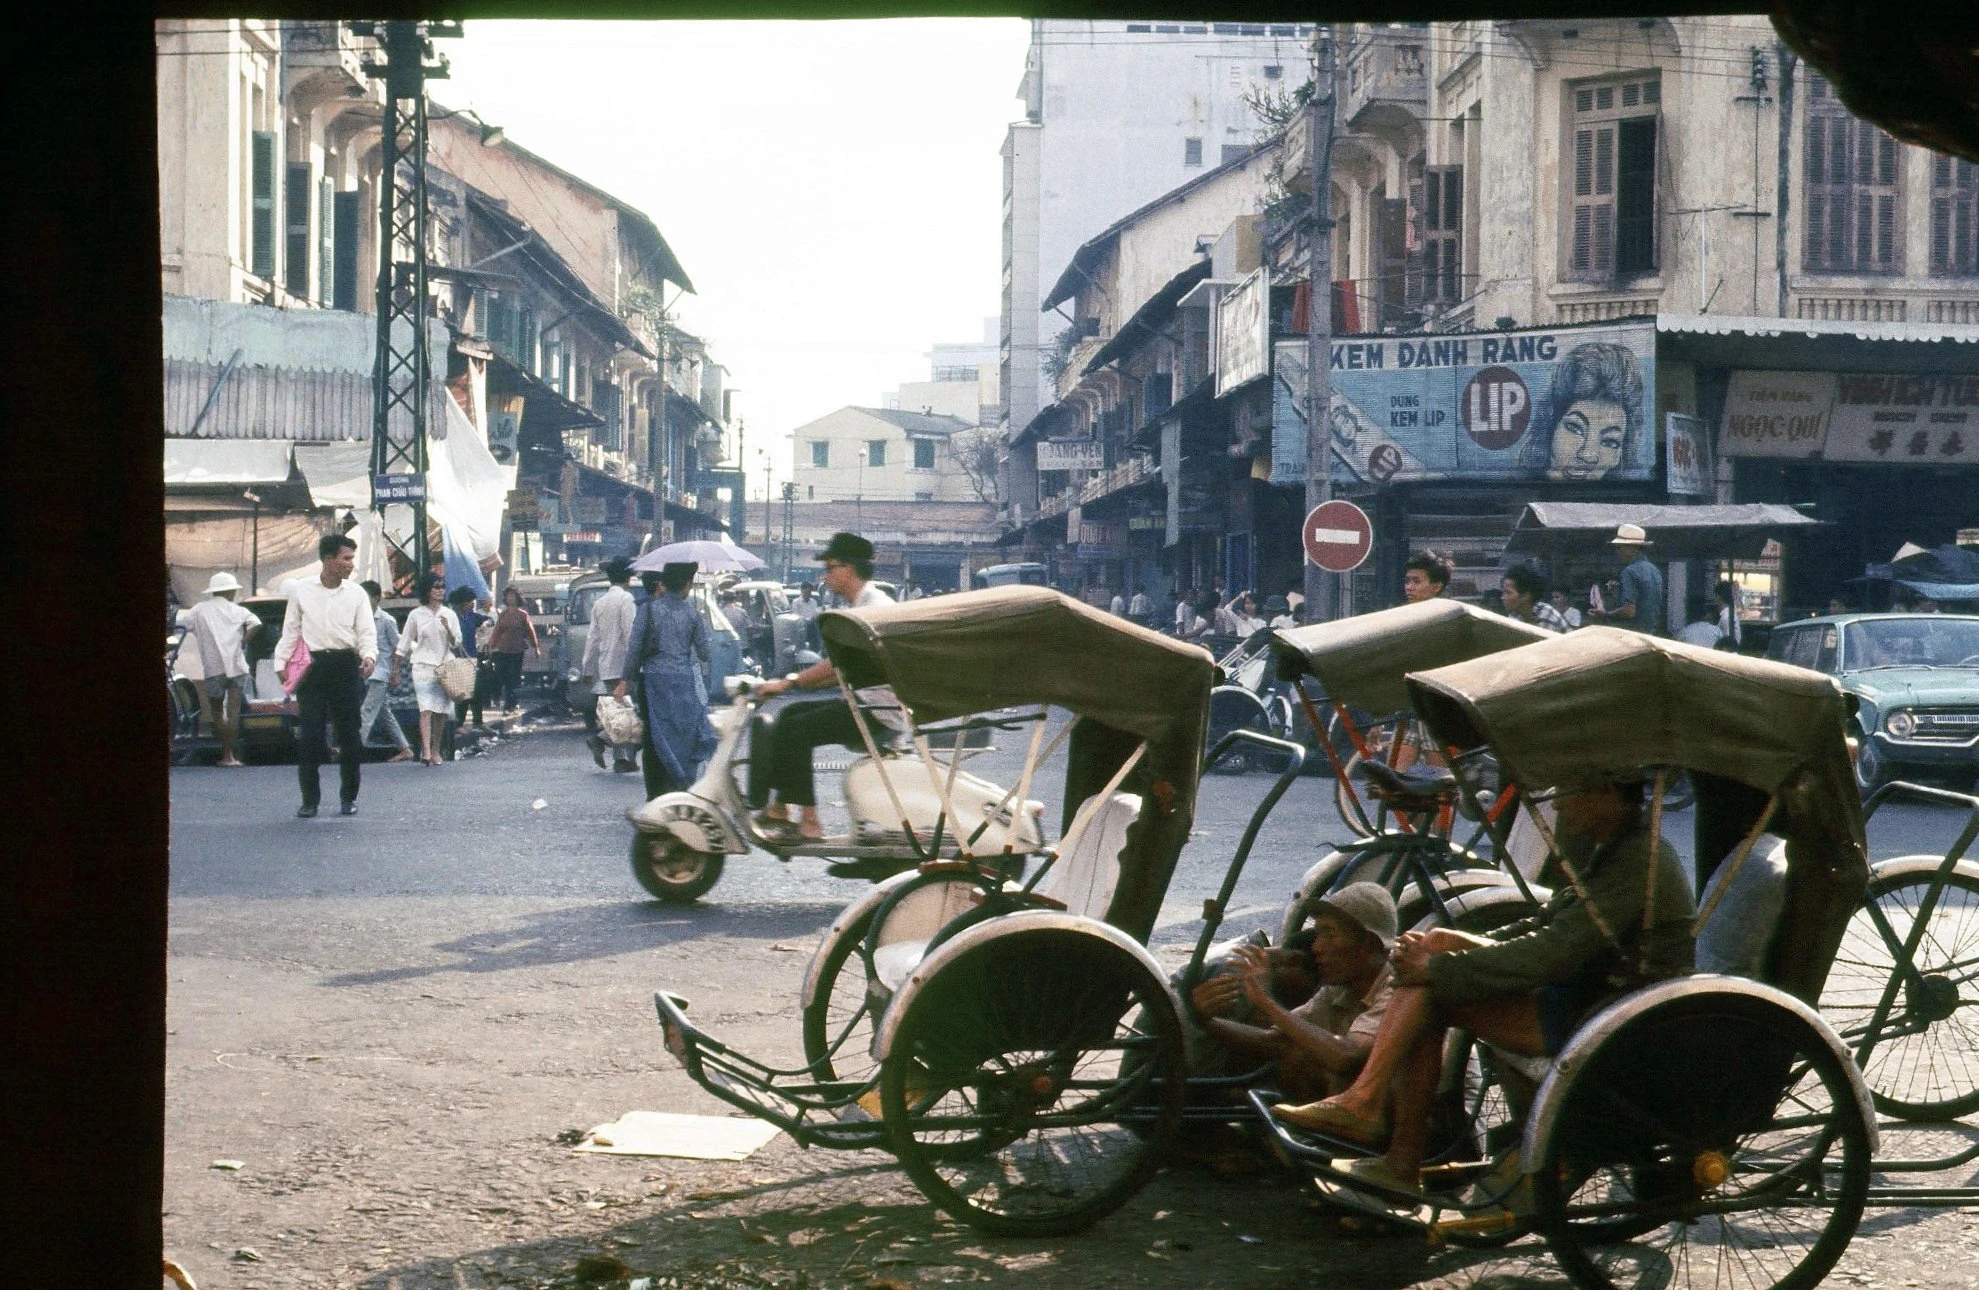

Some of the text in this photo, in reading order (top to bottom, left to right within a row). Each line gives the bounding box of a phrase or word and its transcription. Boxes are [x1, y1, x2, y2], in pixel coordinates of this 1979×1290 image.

[1331, 343, 1383, 369] KEM
[1391, 410, 1446, 427] KEM LIP
[1470, 382, 1526, 431] LIP
[1373, 447, 1398, 478] LIP
